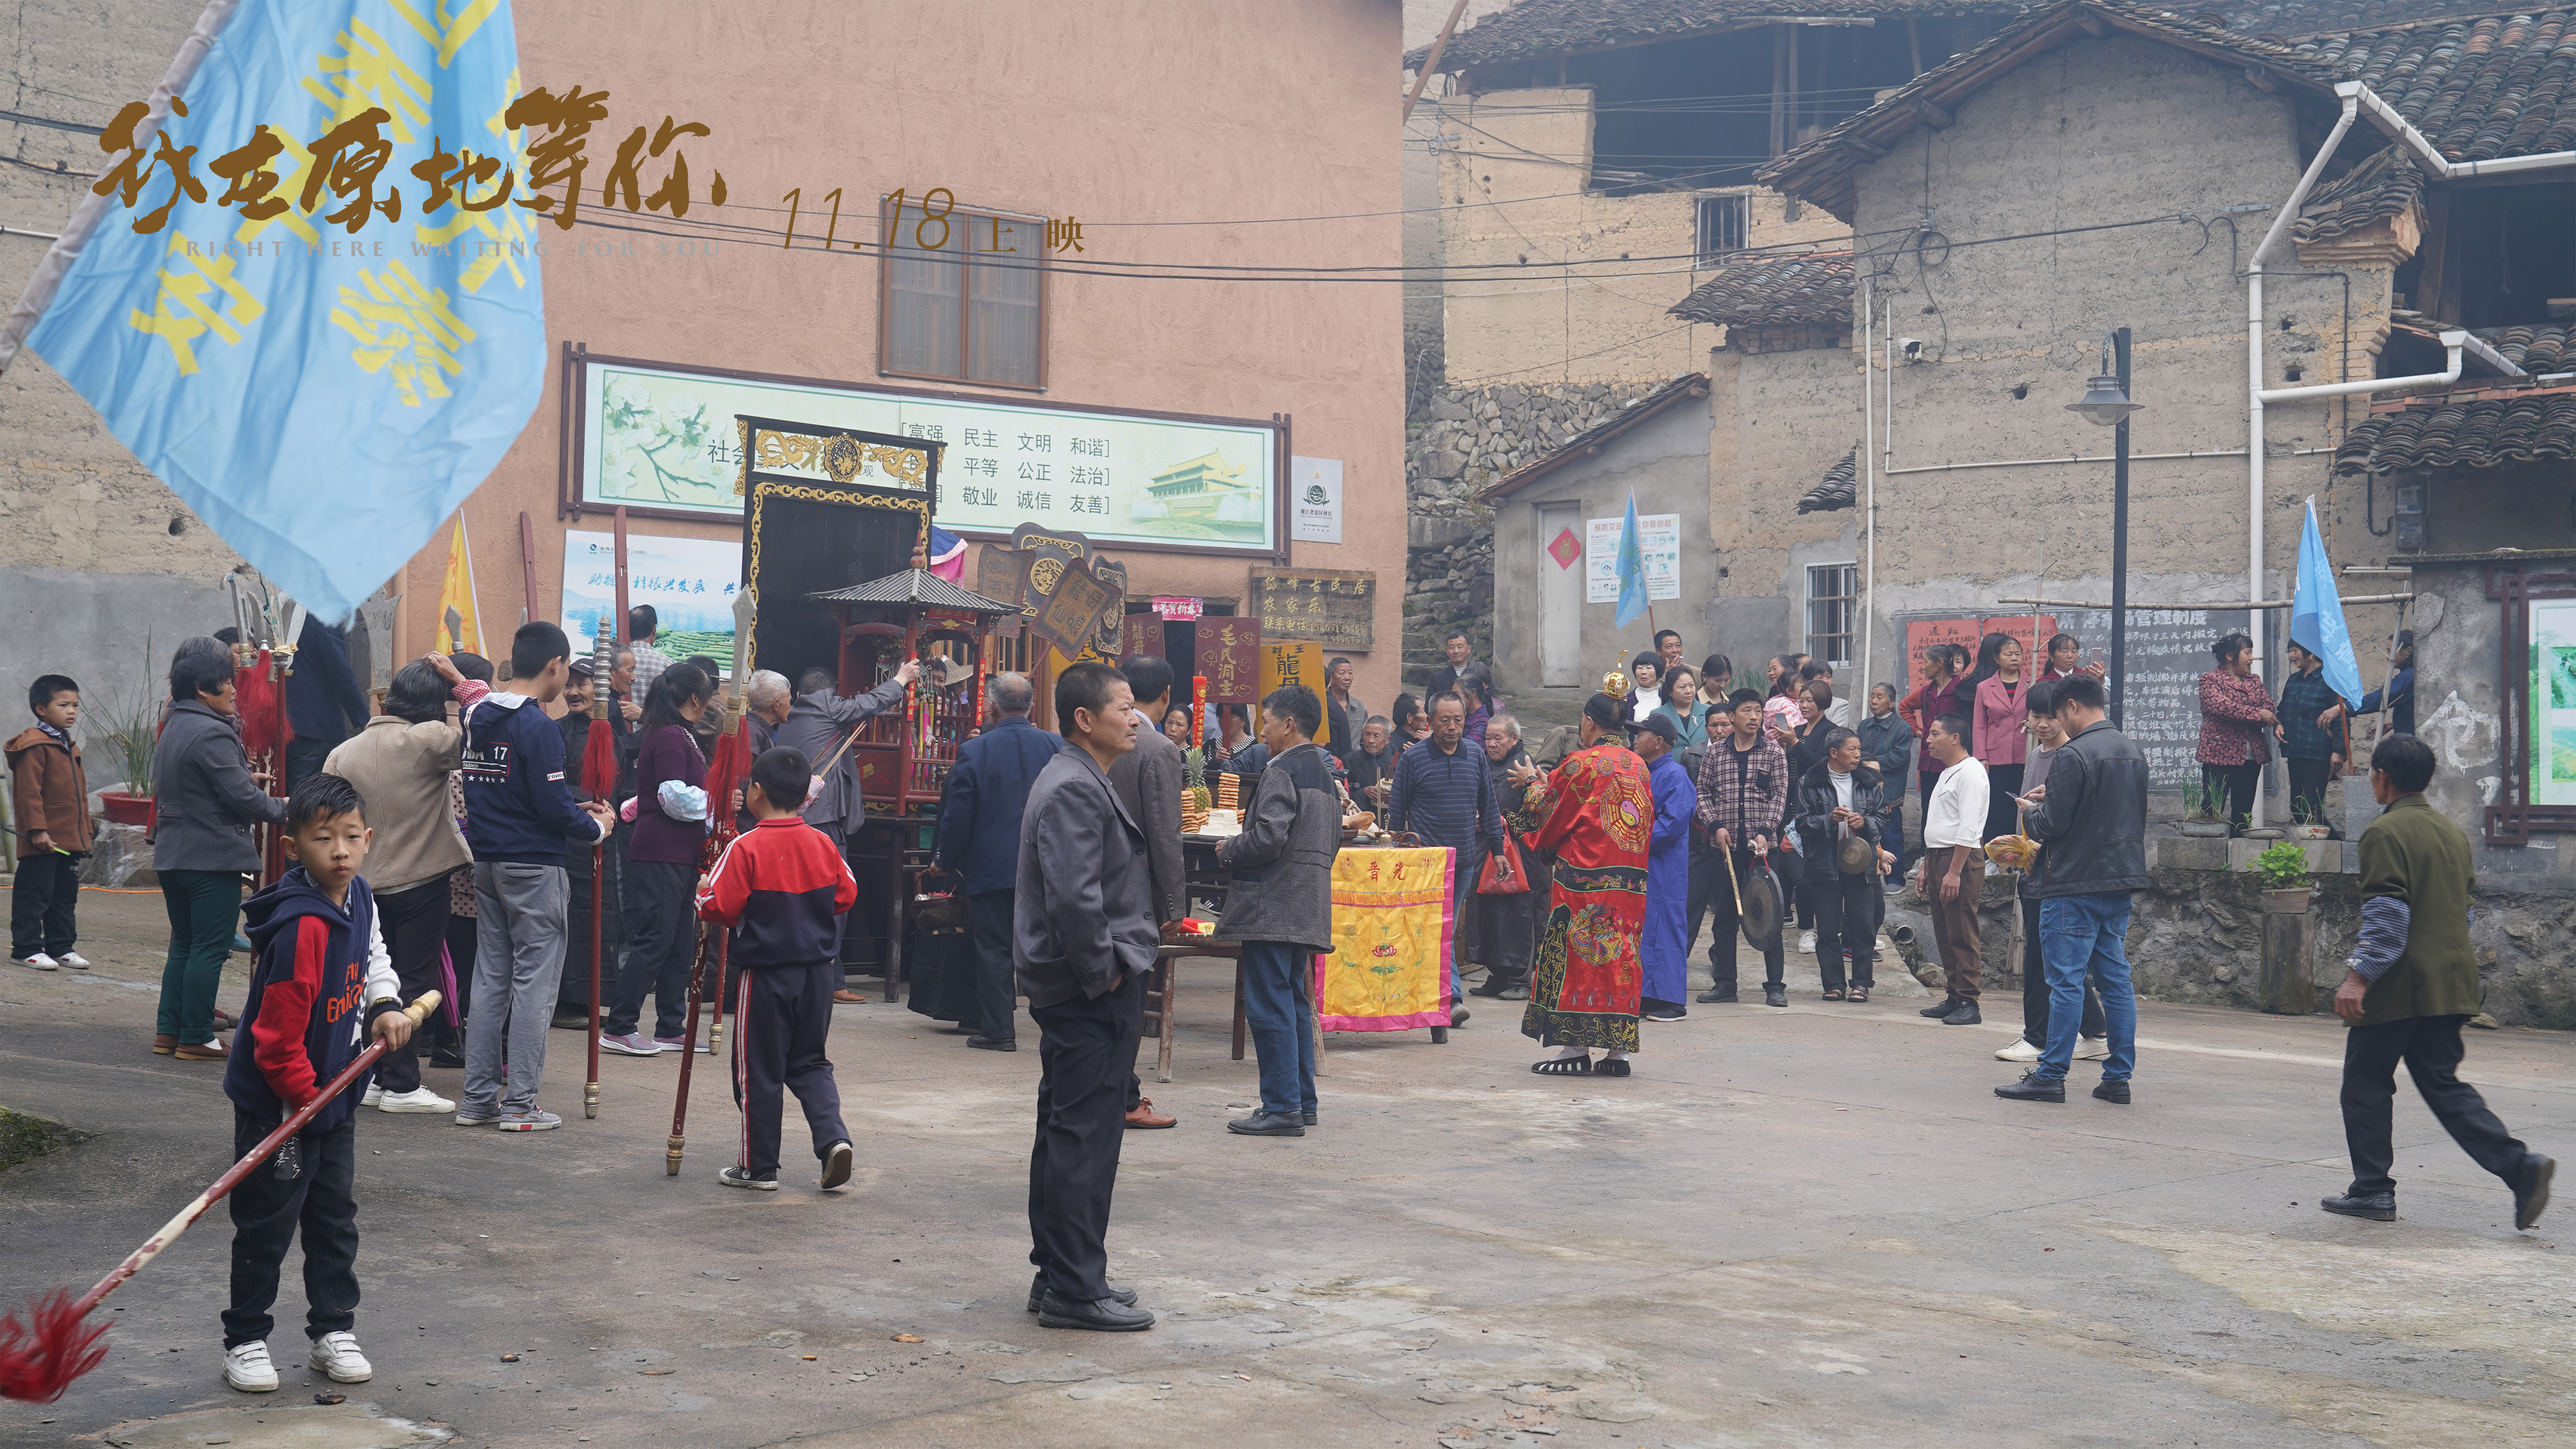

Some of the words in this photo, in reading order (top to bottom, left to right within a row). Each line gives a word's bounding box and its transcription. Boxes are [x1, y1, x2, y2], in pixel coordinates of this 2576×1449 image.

[964, 428, 998, 447] 民主
[1017, 433, 1051, 452] 文明
[964, 457, 998, 477] 平等
[1017, 461, 1051, 481] 公正
[963, 486, 997, 506] 敬业
[1017, 490, 1051, 511] 诚信
[588, 573, 705, 594] 助推村振兴发展
[1265, 573, 1365, 595] 岱峰古民居
[1264, 595, 1321, 613] 农家乐
[1929, 626, 1959, 637] 通知
[494, 745, 508, 760] 17
[345, 961, 359, 985] Fly
